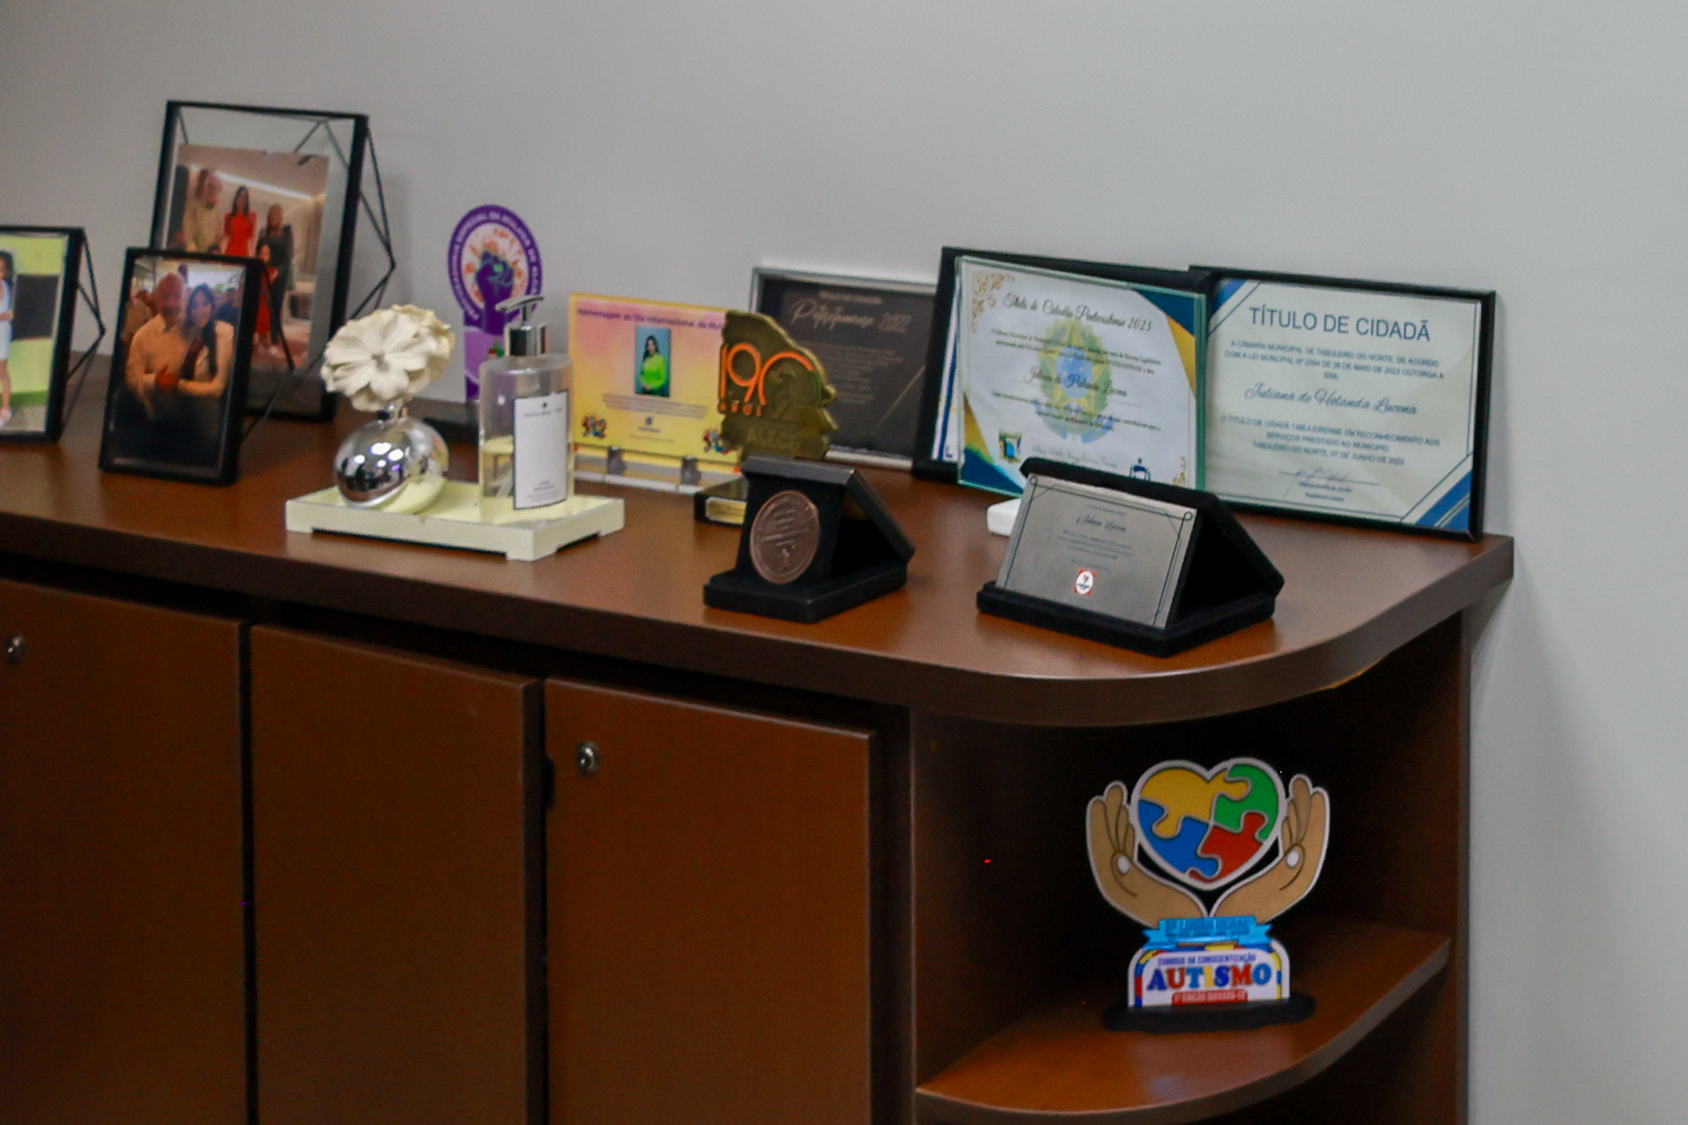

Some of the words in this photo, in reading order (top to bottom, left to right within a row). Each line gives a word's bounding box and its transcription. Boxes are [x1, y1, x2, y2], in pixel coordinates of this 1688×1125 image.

[1249, 304, 1318, 331] TÍTULO
[1323, 314, 1349, 334] DE
[1356, 317, 1431, 342] CIDADÃ
[1314, 388, 1370, 409] Holanda
[1373, 397, 1417, 415] Lucena
[1146, 963, 1272, 991] AUTISMO
